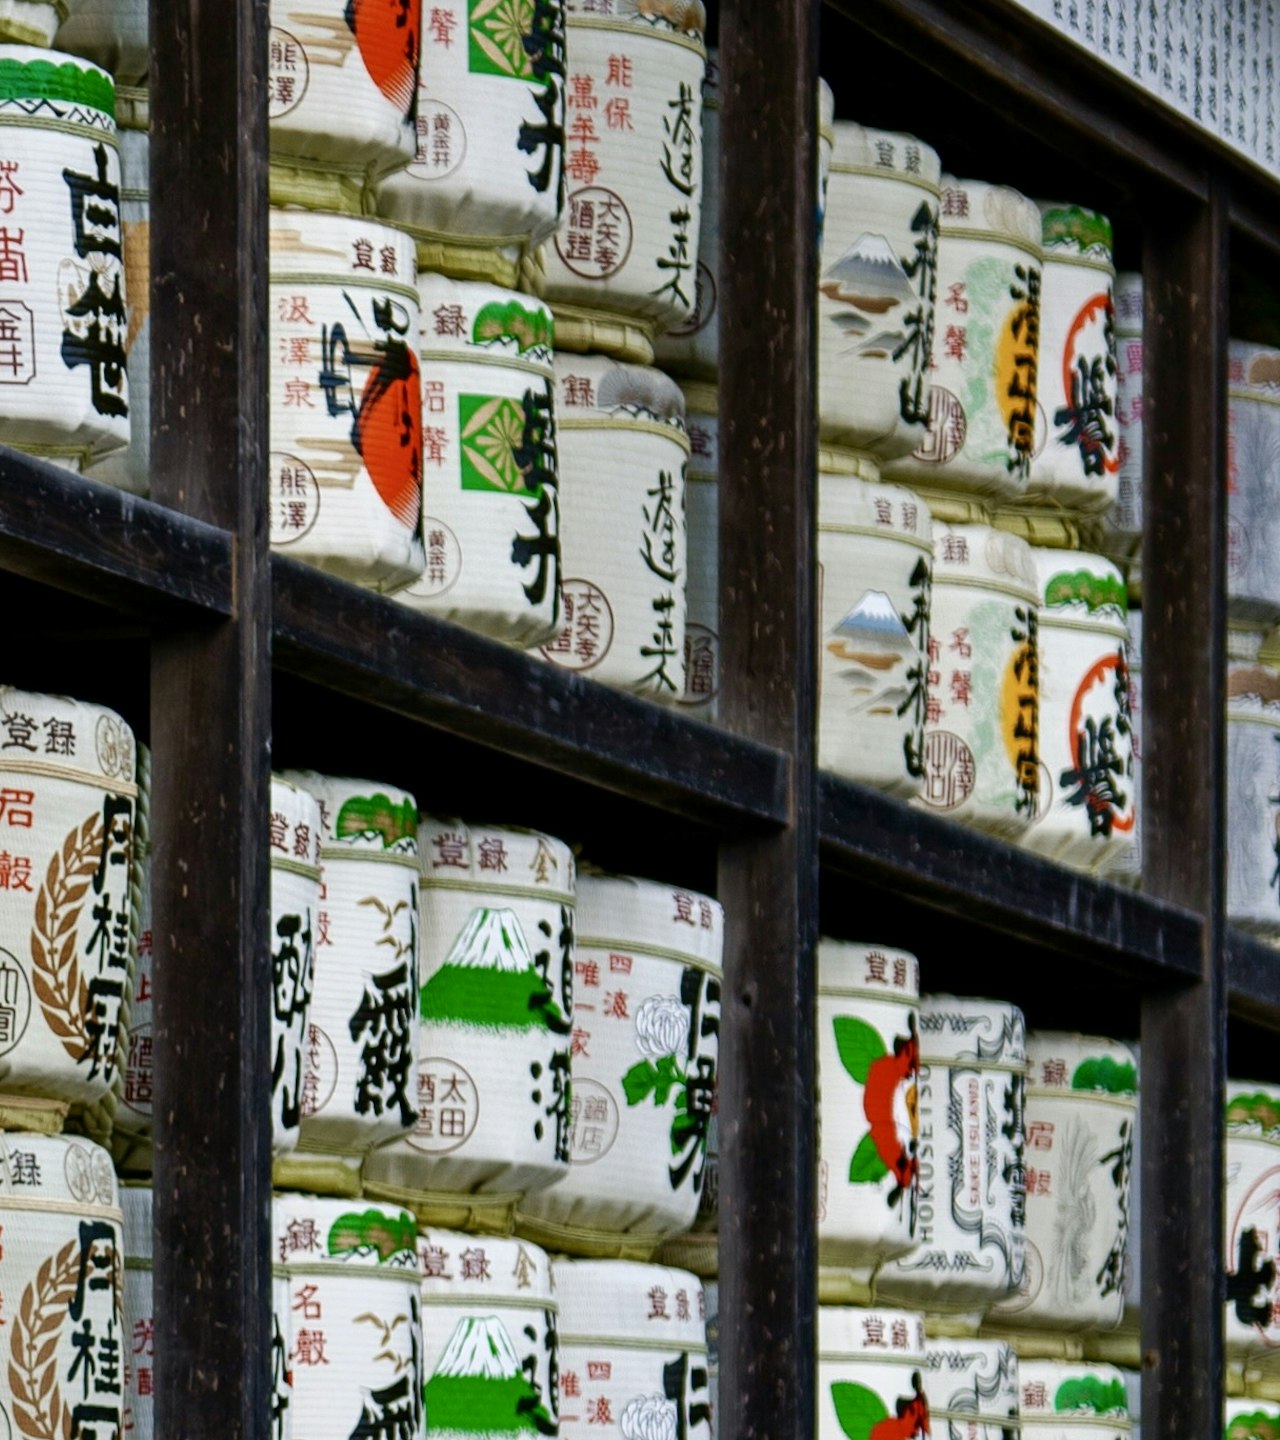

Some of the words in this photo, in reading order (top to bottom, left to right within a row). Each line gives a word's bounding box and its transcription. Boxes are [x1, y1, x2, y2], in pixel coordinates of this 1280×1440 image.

[1, 711, 78, 757] 登録
[80, 794, 136, 1082] 月桂冠
